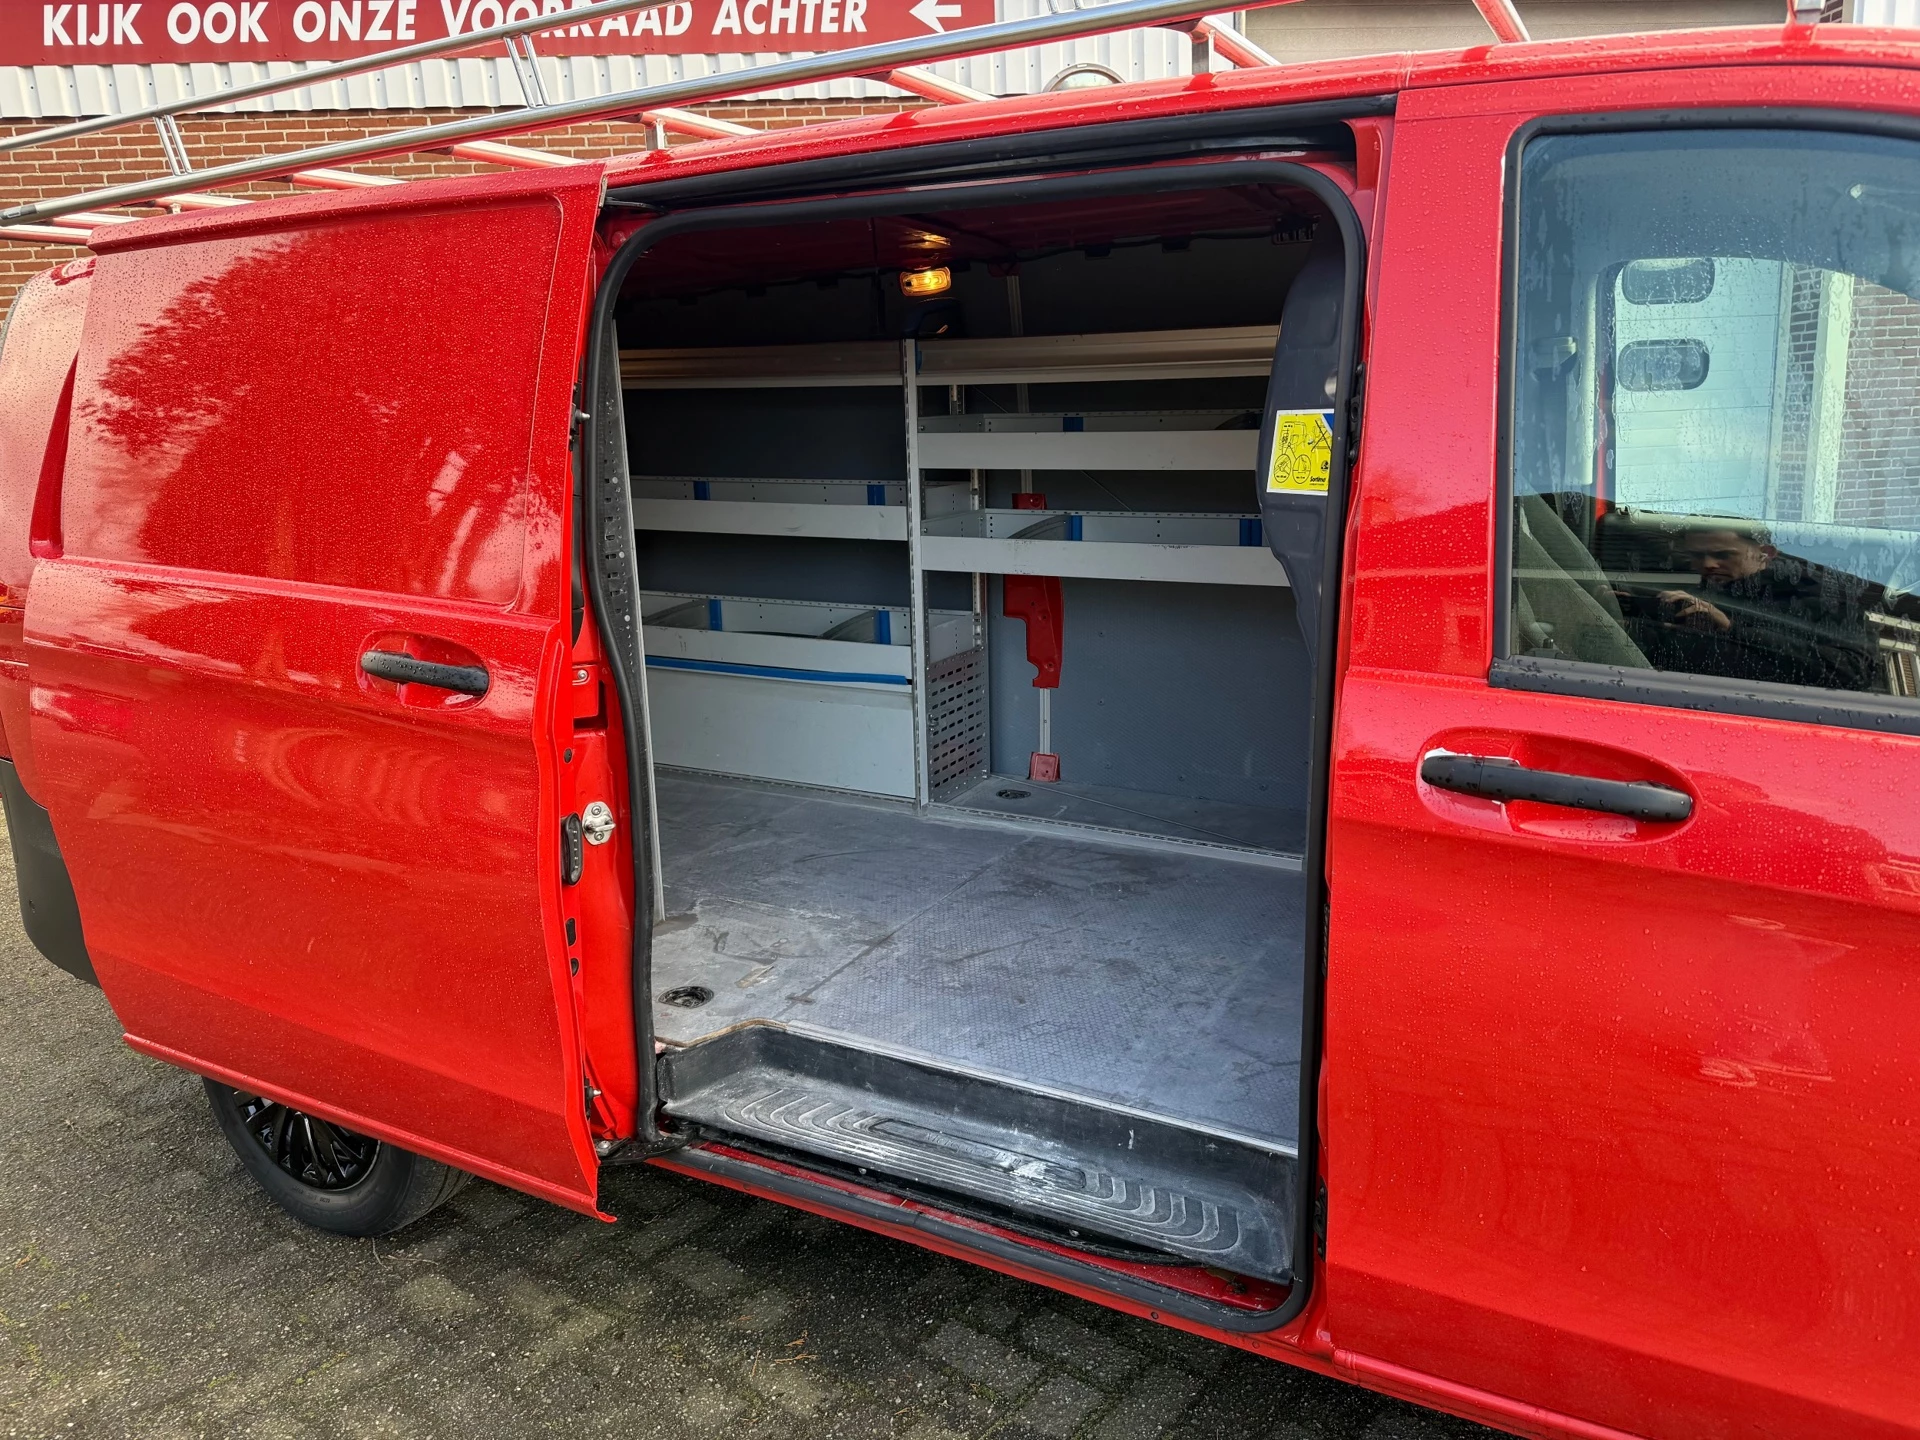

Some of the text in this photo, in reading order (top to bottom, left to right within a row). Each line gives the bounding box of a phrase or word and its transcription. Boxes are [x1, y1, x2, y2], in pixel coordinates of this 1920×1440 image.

[43, 3, 144, 46] KIJK
[167, 2, 270, 44] OOK
[293, 0, 417, 43] ONZE
[711, 0, 868, 36] ACHTER
